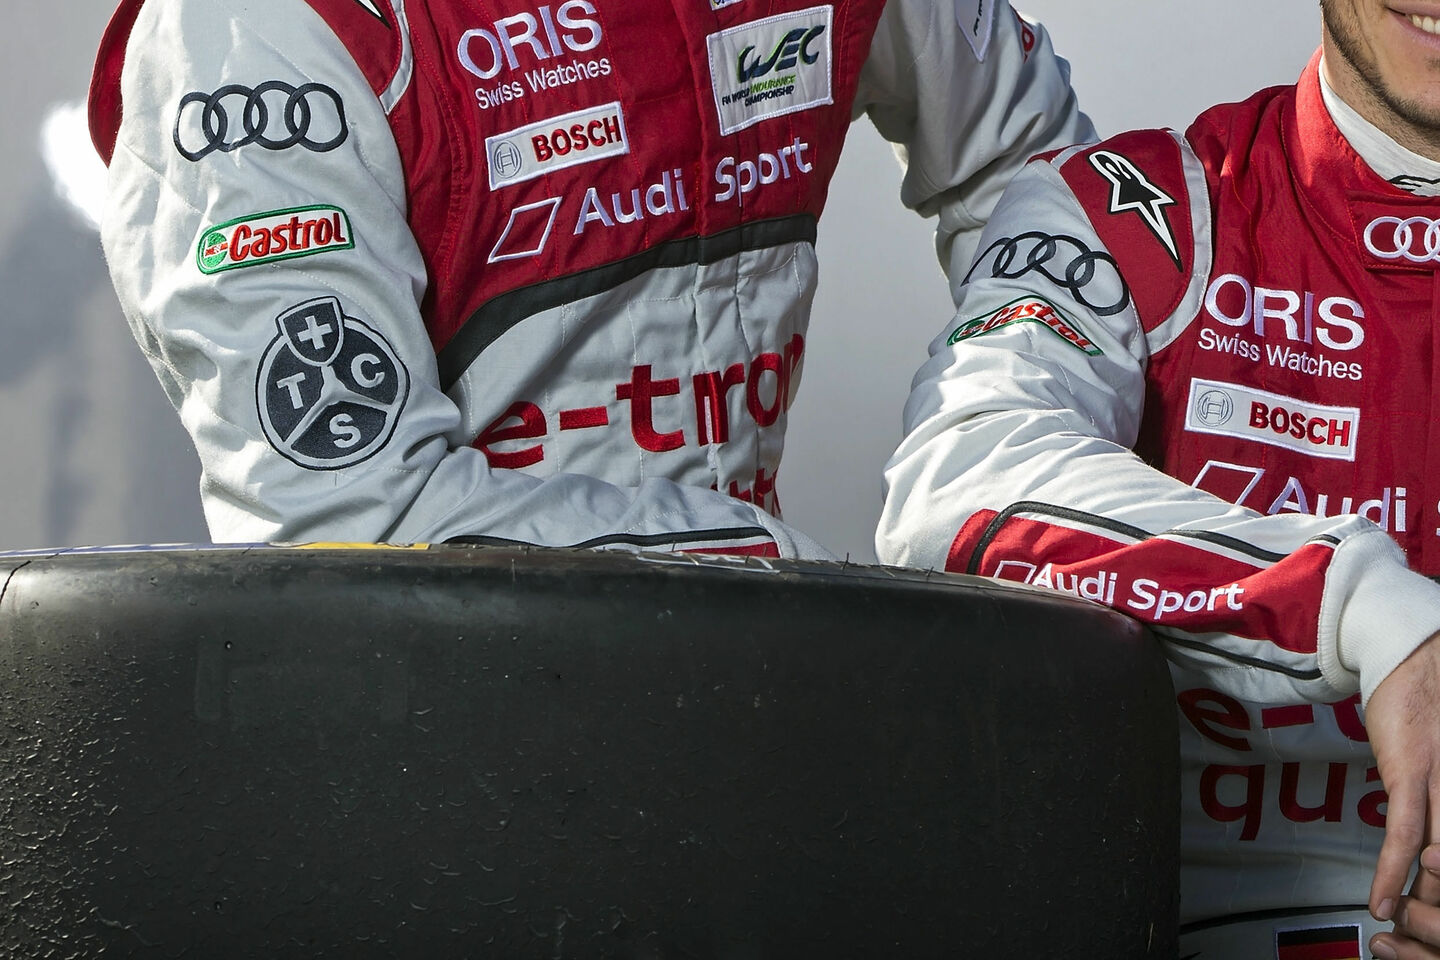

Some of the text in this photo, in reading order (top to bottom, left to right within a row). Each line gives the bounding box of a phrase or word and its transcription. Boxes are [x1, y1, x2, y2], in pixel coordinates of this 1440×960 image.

[457, 0, 602, 79] ORIS
[475, 55, 612, 110] Swiss Watches
[531, 114, 622, 163] BOSCH
[573, 136, 813, 235] Audi Sport
[229, 212, 347, 261] Castrol
[982, 302, 1091, 350] Castrol
[1204, 273, 1365, 350] ORIS
[1198, 327, 1363, 381] Swiss Watches
[472, 333, 805, 469] e-tron
[1249, 400, 1351, 448] BOSCH
[1032, 563, 1244, 620] Audi Sport
